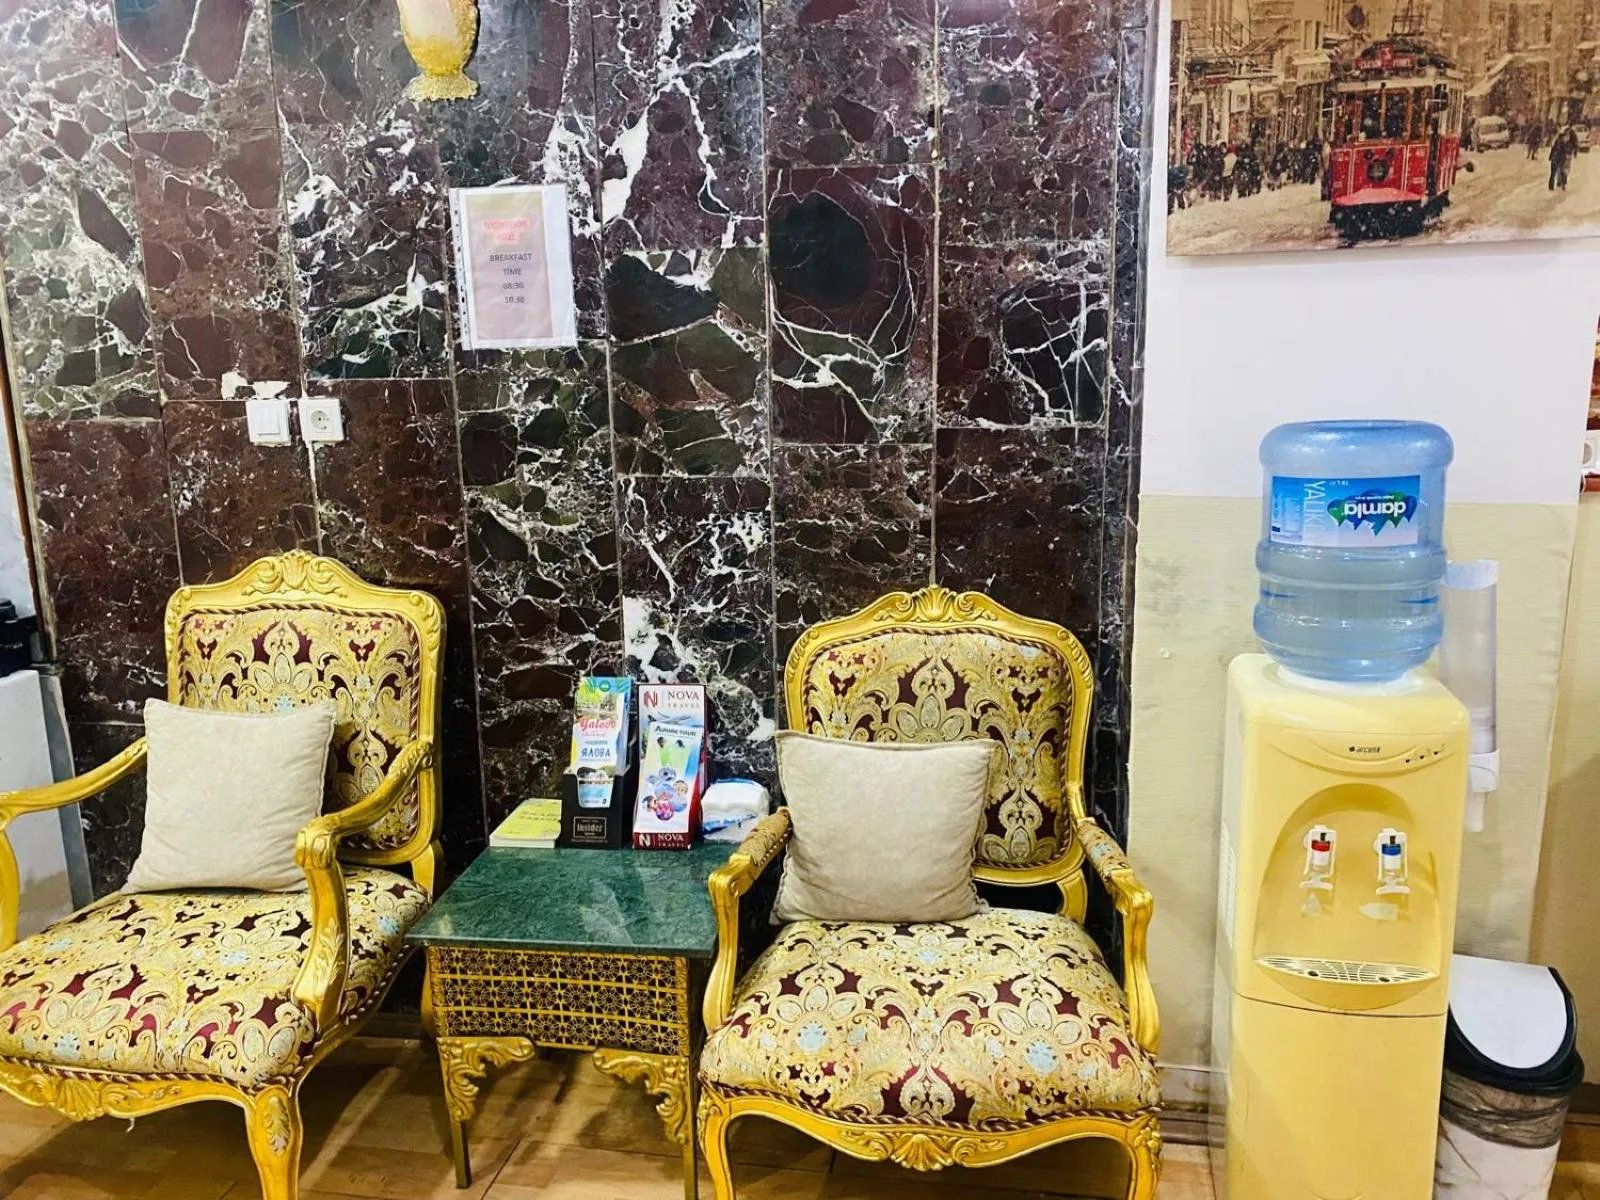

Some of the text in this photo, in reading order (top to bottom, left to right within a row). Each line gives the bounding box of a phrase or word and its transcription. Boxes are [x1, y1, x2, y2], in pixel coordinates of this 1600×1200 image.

[489, 253, 532, 262] BREAKFAST
[1344, 502, 1406, 518] damla
[667, 690, 699, 700] NOVA
[658, 833, 684, 841] NOVA
